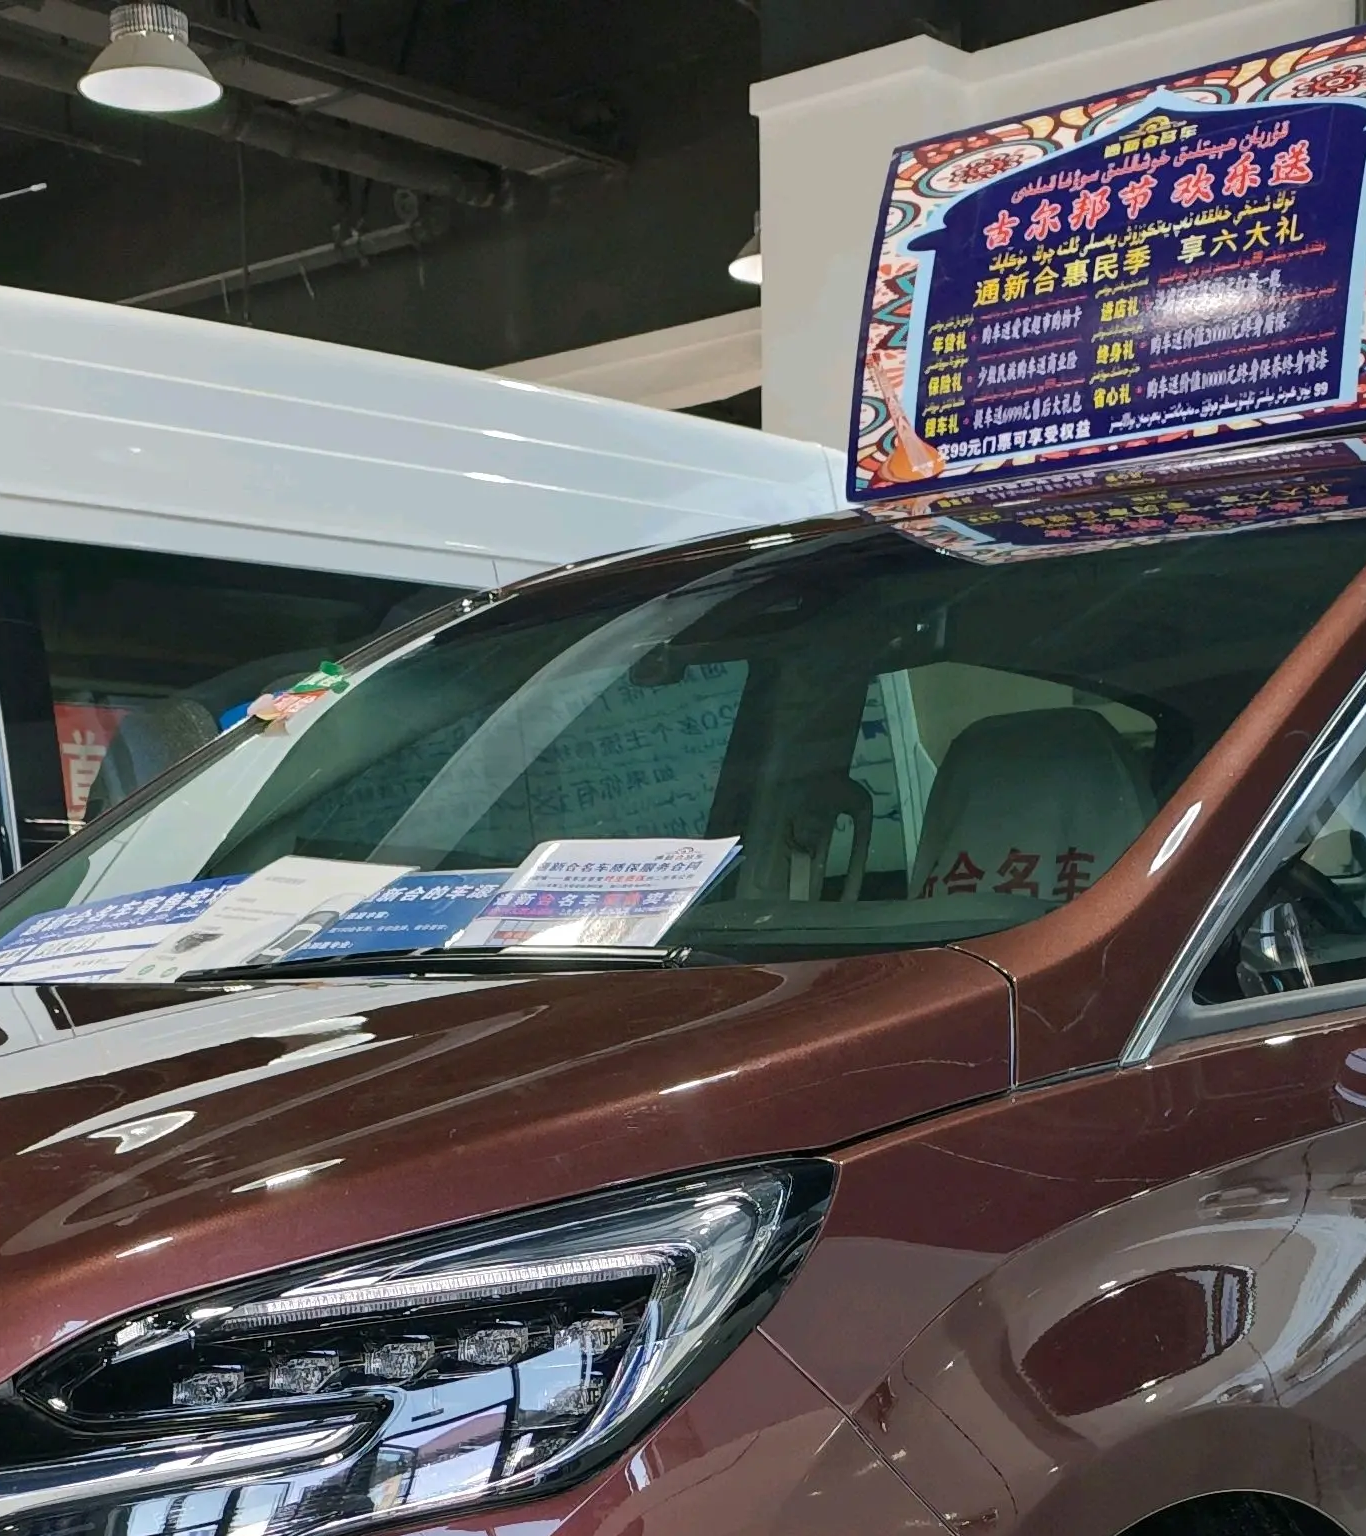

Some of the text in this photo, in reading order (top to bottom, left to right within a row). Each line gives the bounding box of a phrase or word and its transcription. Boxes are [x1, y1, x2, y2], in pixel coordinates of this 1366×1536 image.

[983, 140, 1314, 249] 古尔邦节 欢乐送
[973, 245, 1151, 308] 通新合惠民季
[1177, 214, 1304, 264] 享六大礼
